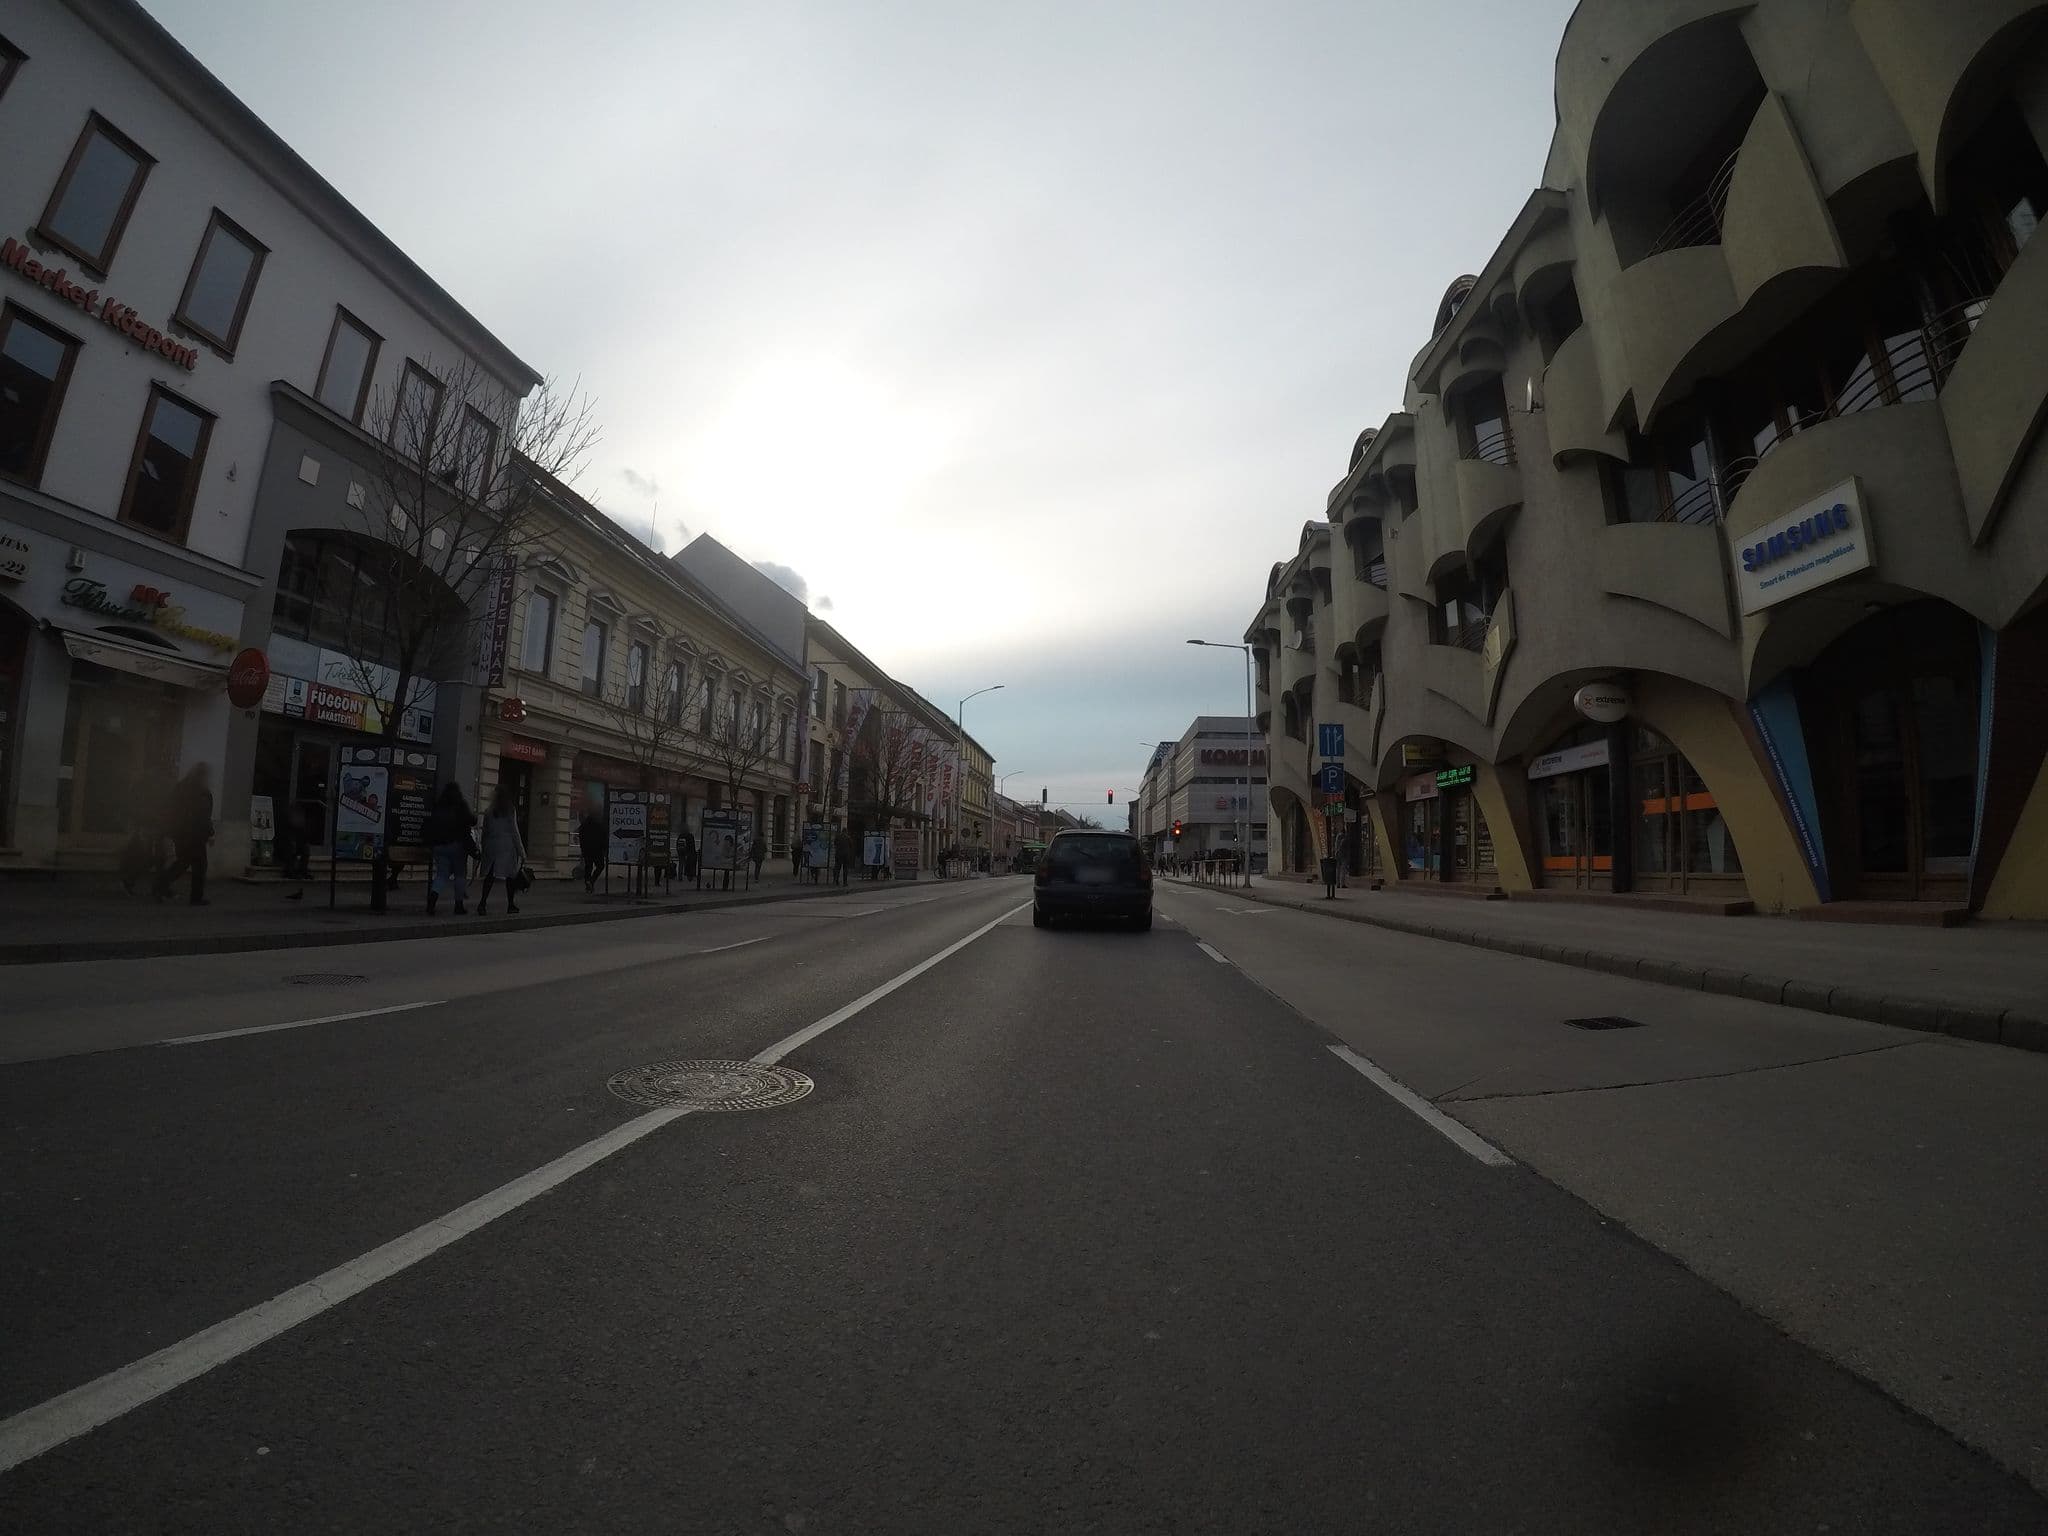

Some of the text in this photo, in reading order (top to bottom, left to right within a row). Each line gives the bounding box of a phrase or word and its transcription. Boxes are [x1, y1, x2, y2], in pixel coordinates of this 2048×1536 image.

[0, 237, 198, 371] Market Központ
[1742, 503, 1849, 572] SAMSUNG
[311, 687, 367, 714] FÜGGÖNY
[1328, 769, 1338, 784] P
[613, 817, 643, 826] ISKOLA
